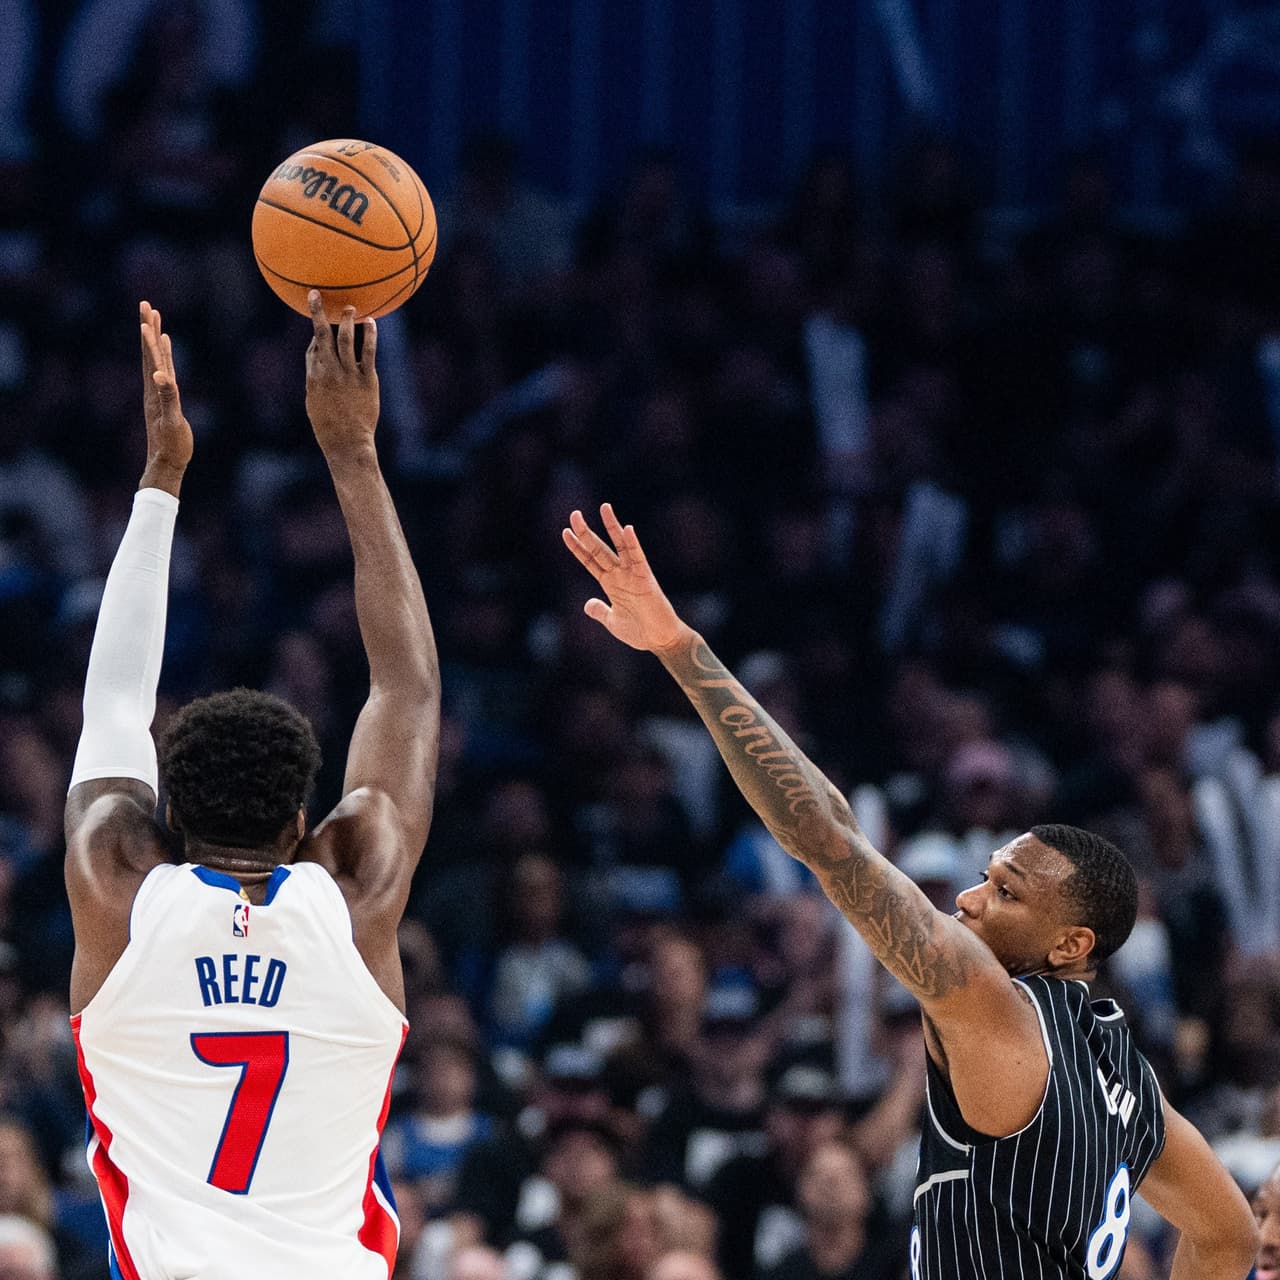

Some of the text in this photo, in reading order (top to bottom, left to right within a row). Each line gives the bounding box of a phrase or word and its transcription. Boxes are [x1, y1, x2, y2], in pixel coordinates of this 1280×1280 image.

[272, 163, 369, 227] Wilson
[195, 953, 287, 1008] REED
[190, 1031, 290, 1195] 7
